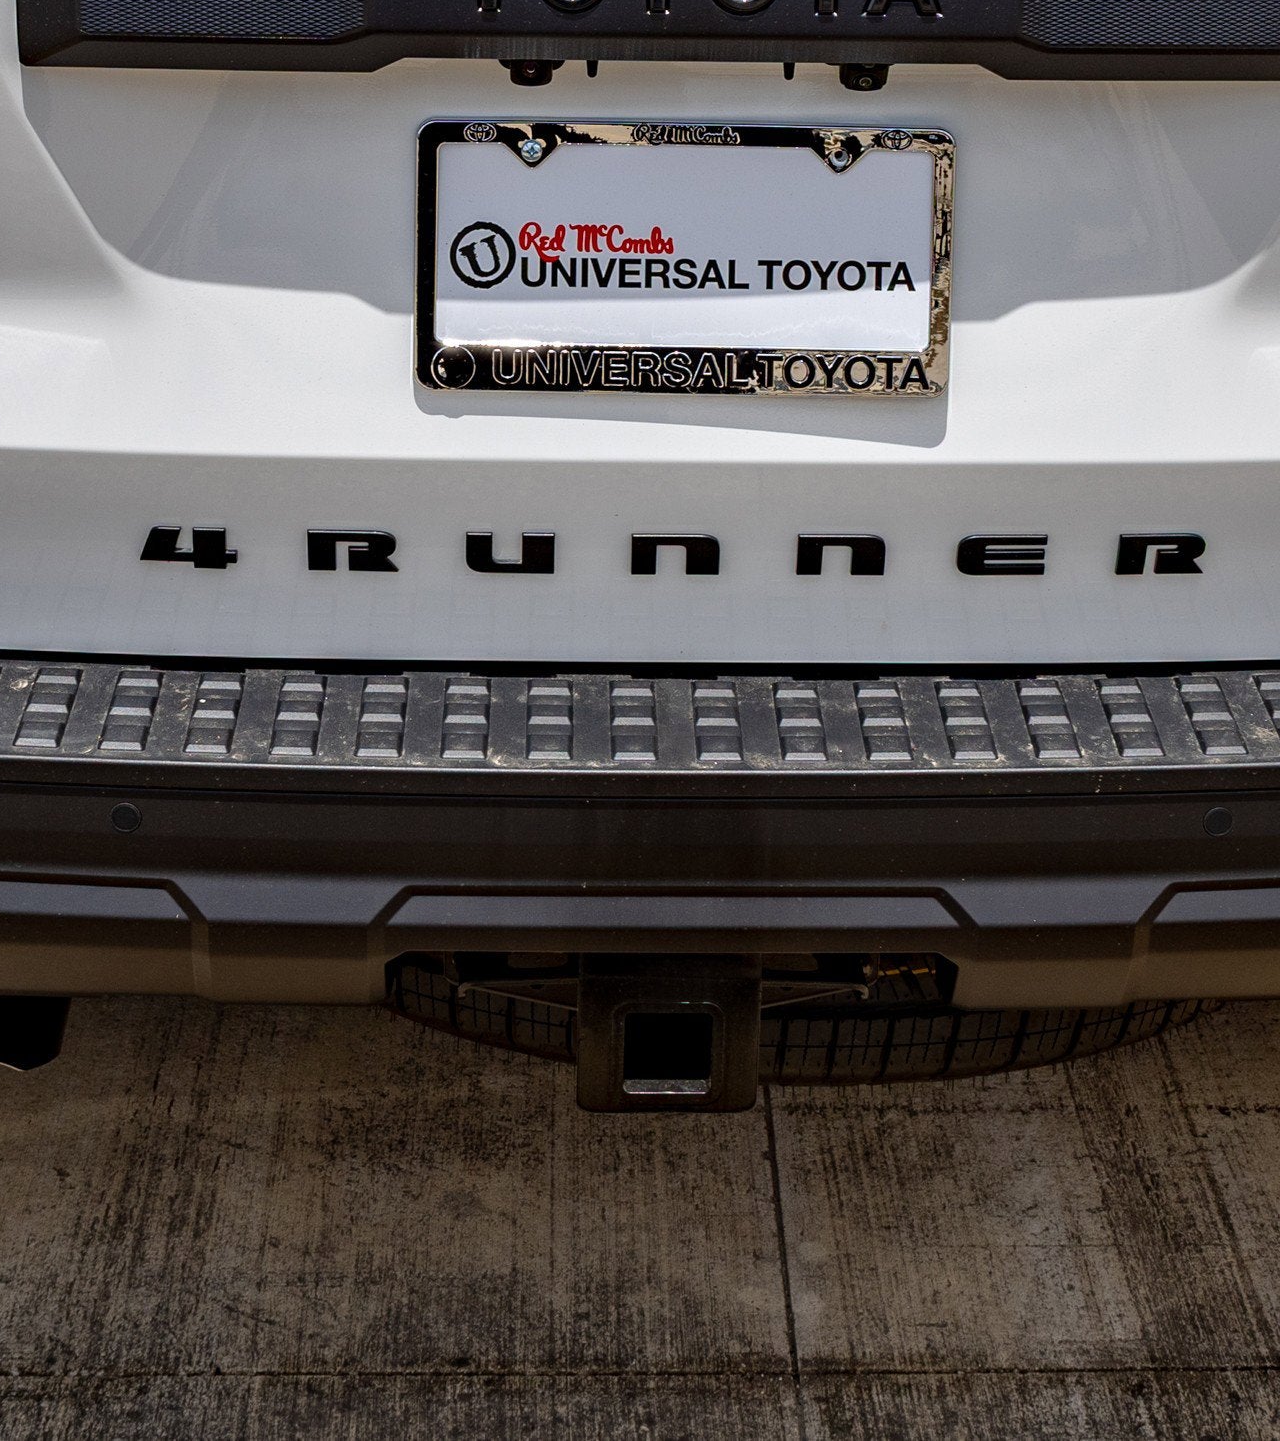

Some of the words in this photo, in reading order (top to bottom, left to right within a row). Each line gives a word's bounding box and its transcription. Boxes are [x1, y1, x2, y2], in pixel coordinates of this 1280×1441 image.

[519, 221, 566, 262] Red
[569, 224, 675, 255] McCombs
[520, 257, 750, 290] UNIVERSAL
[757, 259, 917, 293] TOYOTA
[491, 348, 752, 389] UNIVERSAL
[754, 353, 932, 392] TOYOTA
